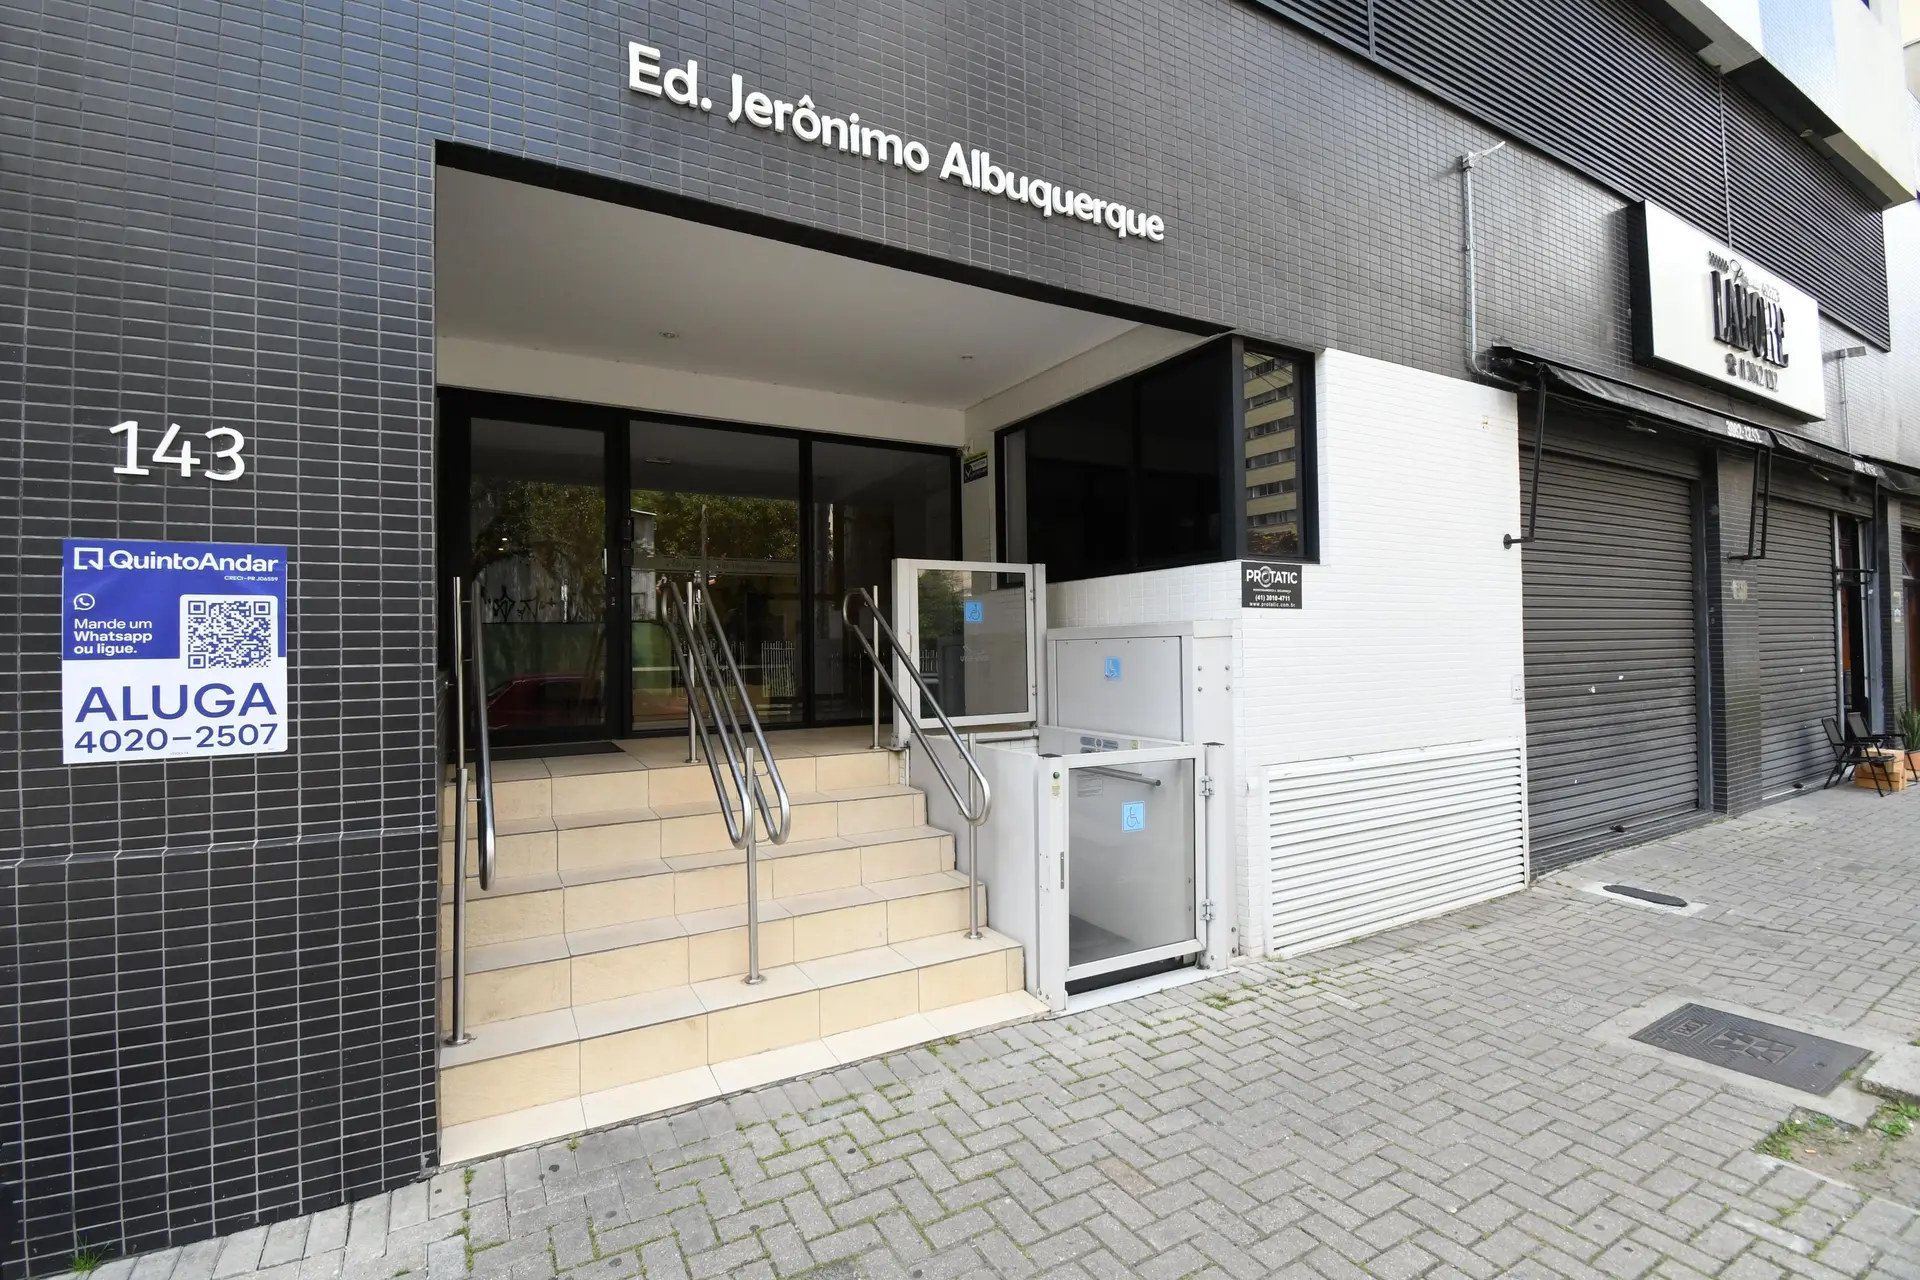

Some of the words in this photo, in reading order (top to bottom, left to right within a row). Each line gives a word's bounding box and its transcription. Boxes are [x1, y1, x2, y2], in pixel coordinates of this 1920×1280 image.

[628, 40, 713, 112] Ed.
[728, 73, 930, 174] Jerônimo
[938, 141, 1165, 243] Albuquerque
[109, 420, 246, 481] 143
[108, 549, 279, 573] QuintoAndar
[1246, 565, 1298, 588] PROTATIC
[74, 618, 127, 629] Mande
[129, 620, 153, 629] um
[73, 630, 153, 644] Whatsapp
[73, 645, 94, 654] ou
[96, 643, 138, 657] ligue.
[75, 682, 278, 723] ALUGA
[74, 723, 278, 754] 4020-2507
